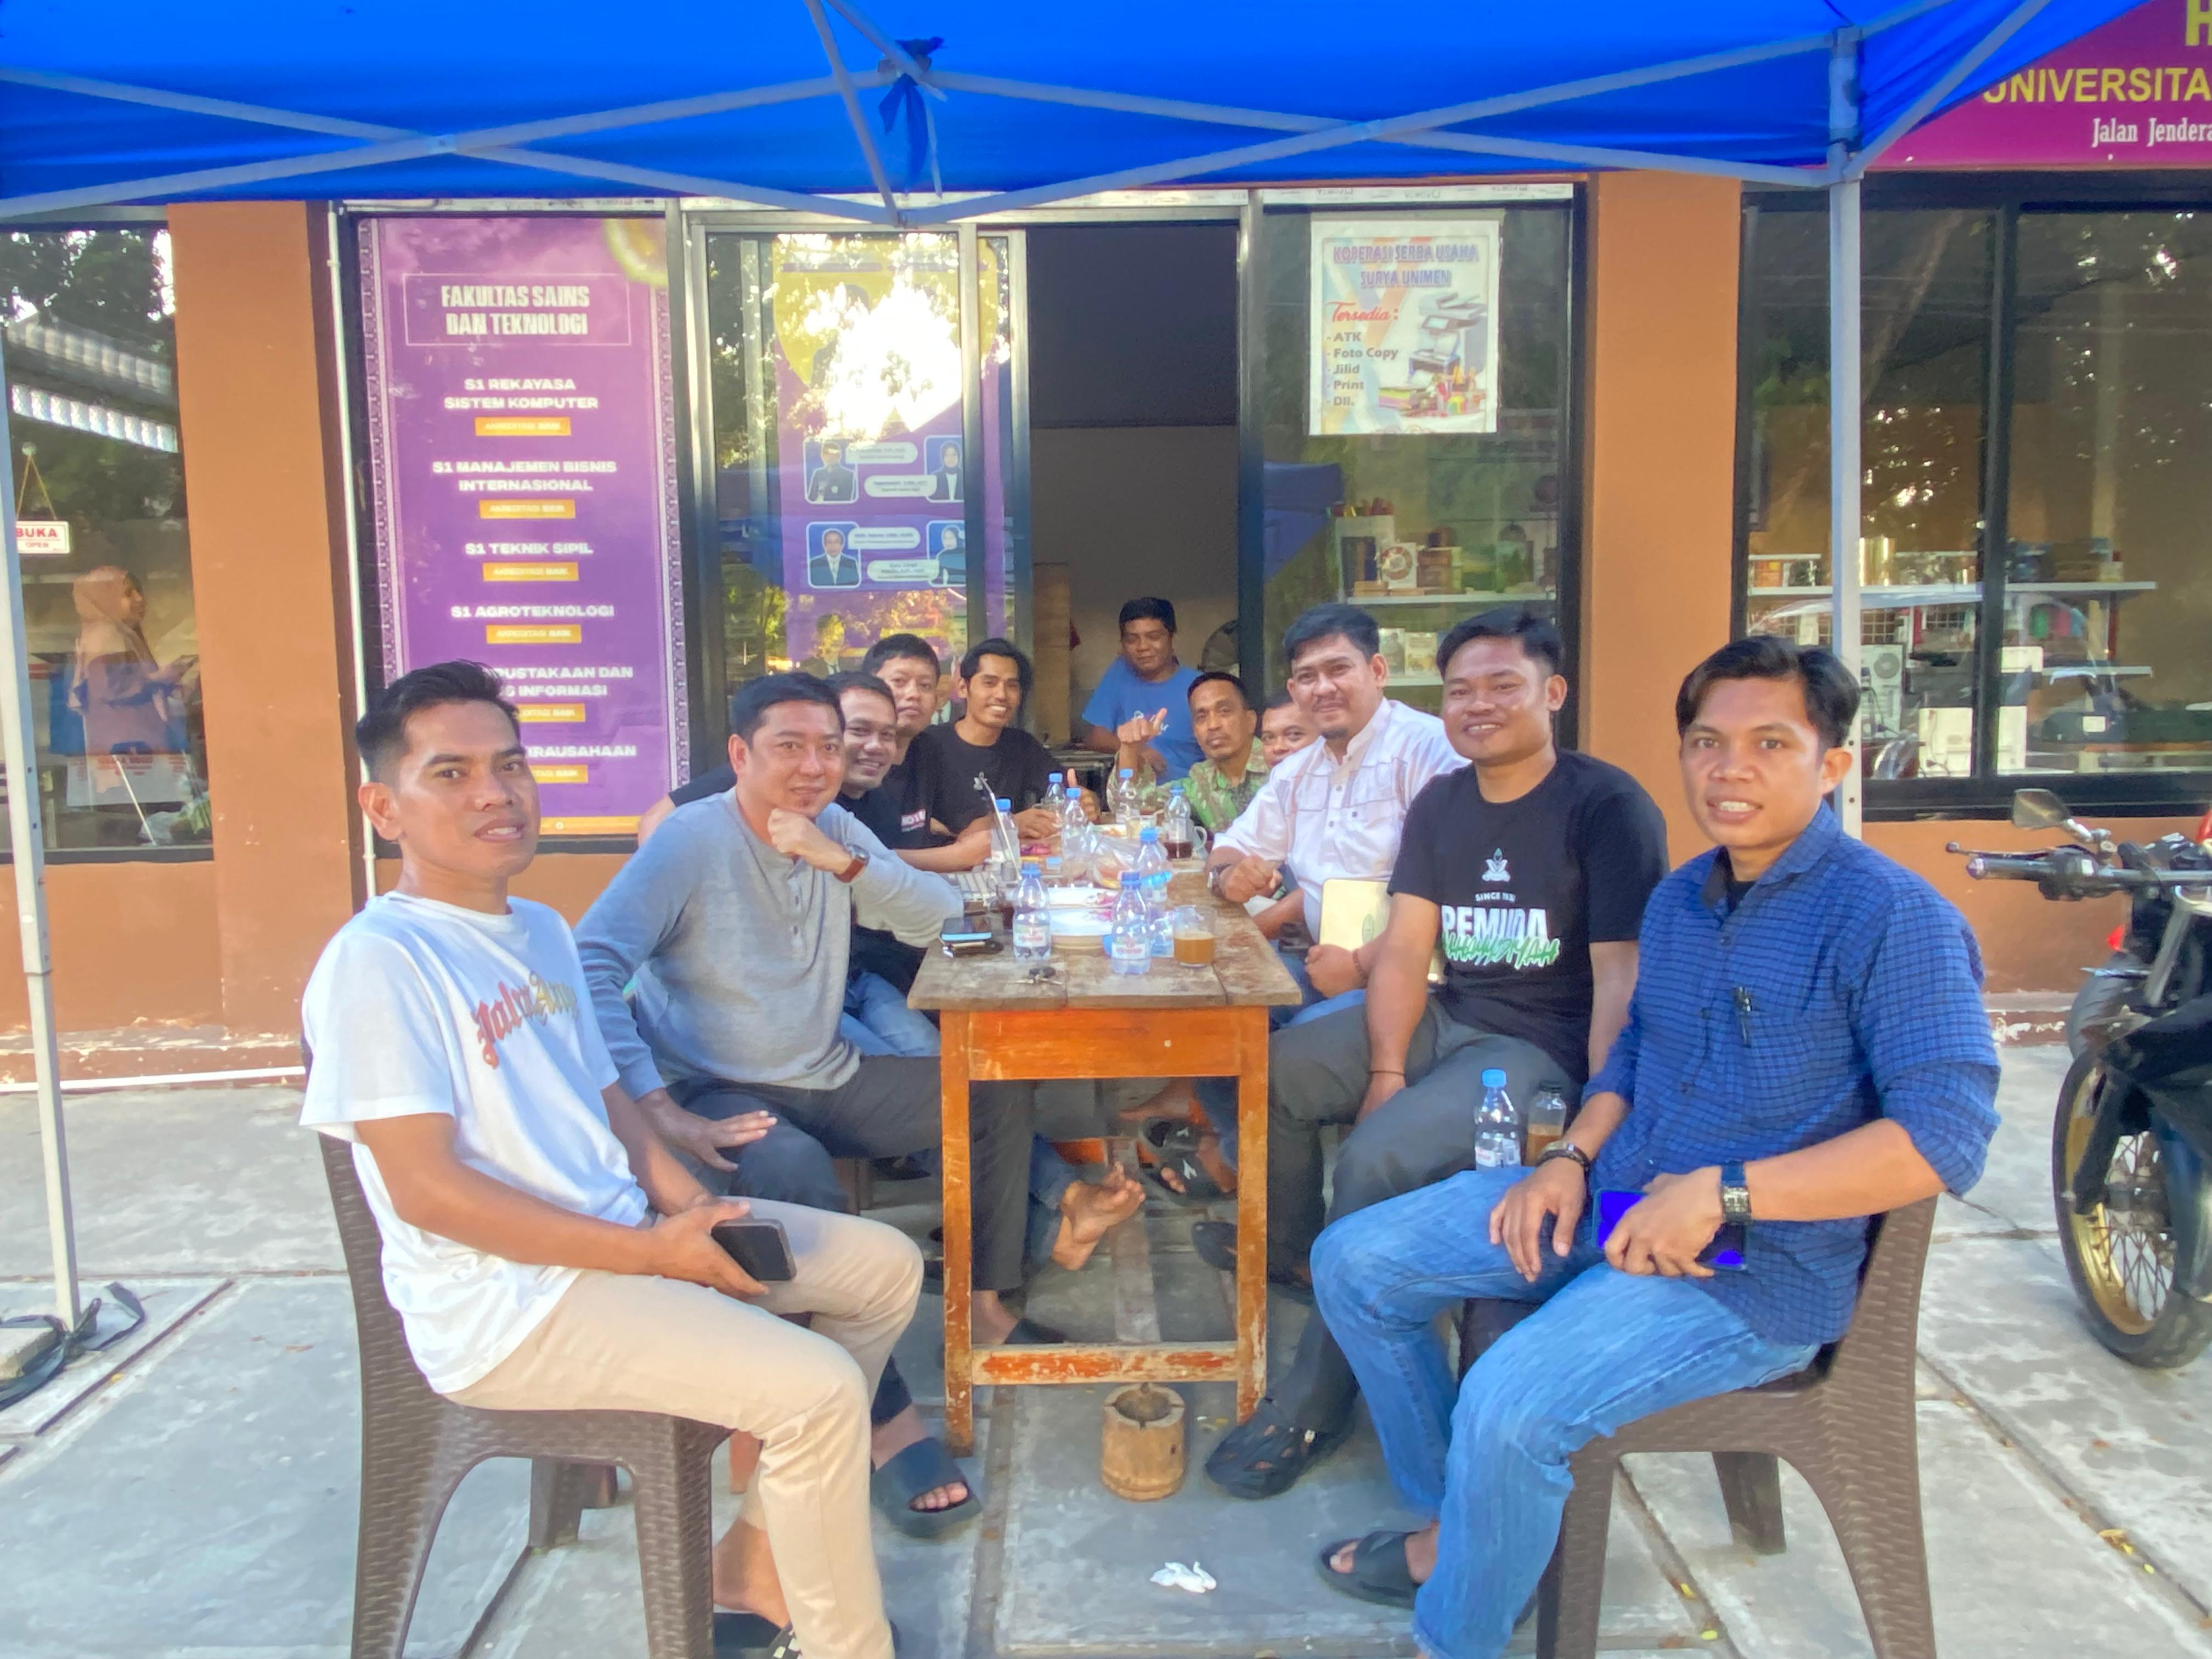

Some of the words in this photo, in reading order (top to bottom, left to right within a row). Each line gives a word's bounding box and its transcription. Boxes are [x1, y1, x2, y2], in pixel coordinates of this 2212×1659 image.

[2091, 117, 2138, 148] Jalan
[1333, 246, 1394, 264] KOPERASI
[1395, 245, 1434, 263] SERBA
[1435, 244, 1480, 262] USAHA
[1361, 270, 1398, 289] SURYA
[1402, 269, 1453, 287] UNIMEN
[441, 285, 529, 307] FAKULTAS
[532, 285, 590, 307] SAINS
[1325, 301, 1391, 323] Tersedia
[446, 313, 488, 335] DAN
[489, 313, 589, 335] TEKNOLOGI
[1333, 332, 1362, 342] ATK
[1334, 348, 1363, 358] Foto
[1365, 347, 1399, 360] Copy
[1333, 364, 1361, 375] Jilid
[465, 379, 485, 391] S1
[488, 379, 576, 391] REKAYASA
[1333, 380, 1364, 390] Print
[444, 397, 505, 410] SISTEM
[507, 397, 599, 410] KOMPUTER
[433, 461, 453, 473] S1
[456, 461, 561, 473] MANAJEMEN
[563, 461, 617, 473] BISNIS
[459, 479, 594, 492] INTERNASIONAL
[15, 528, 58, 538] BUKA
[465, 543, 486, 555] S1
[489, 543, 549, 555] TEKNIK
[552, 543, 593, 555] SIPIL
[451, 606, 472, 618] S1
[475, 605, 614, 618] AGROTEKNOLOGI
[492, 667, 596, 680] PUSTAKAAN
[598, 666, 633, 679] DAN
[518, 685, 607, 697] INFORMASI
[528, 745, 637, 758] IRAUSAHAAN
